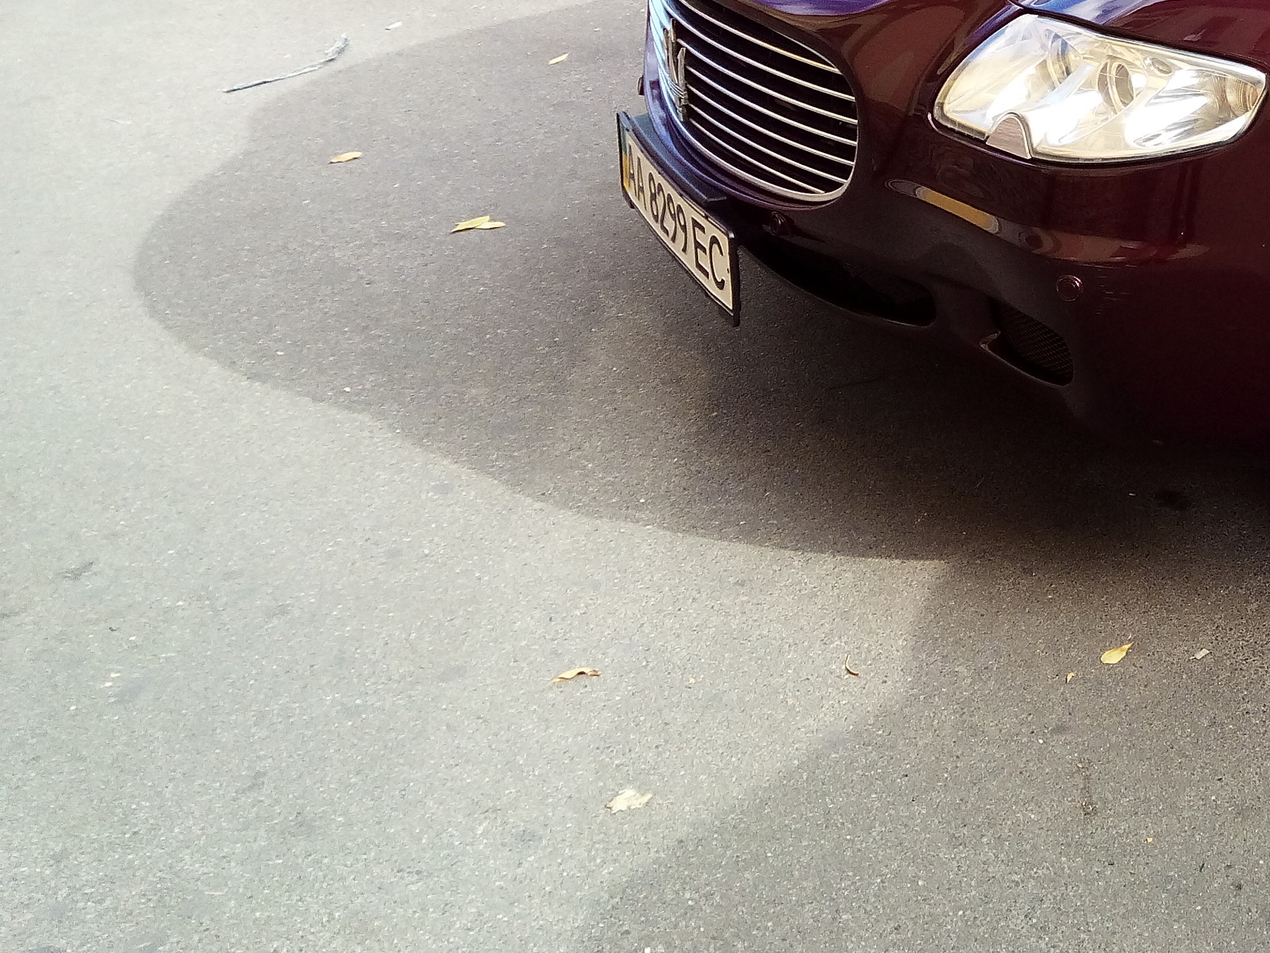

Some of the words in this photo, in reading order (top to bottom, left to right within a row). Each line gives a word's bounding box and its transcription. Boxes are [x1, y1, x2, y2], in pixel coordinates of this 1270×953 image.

[628, 143, 647, 211] AA
[647, 171, 688, 255] 8299
[691, 216, 726, 291] EC
